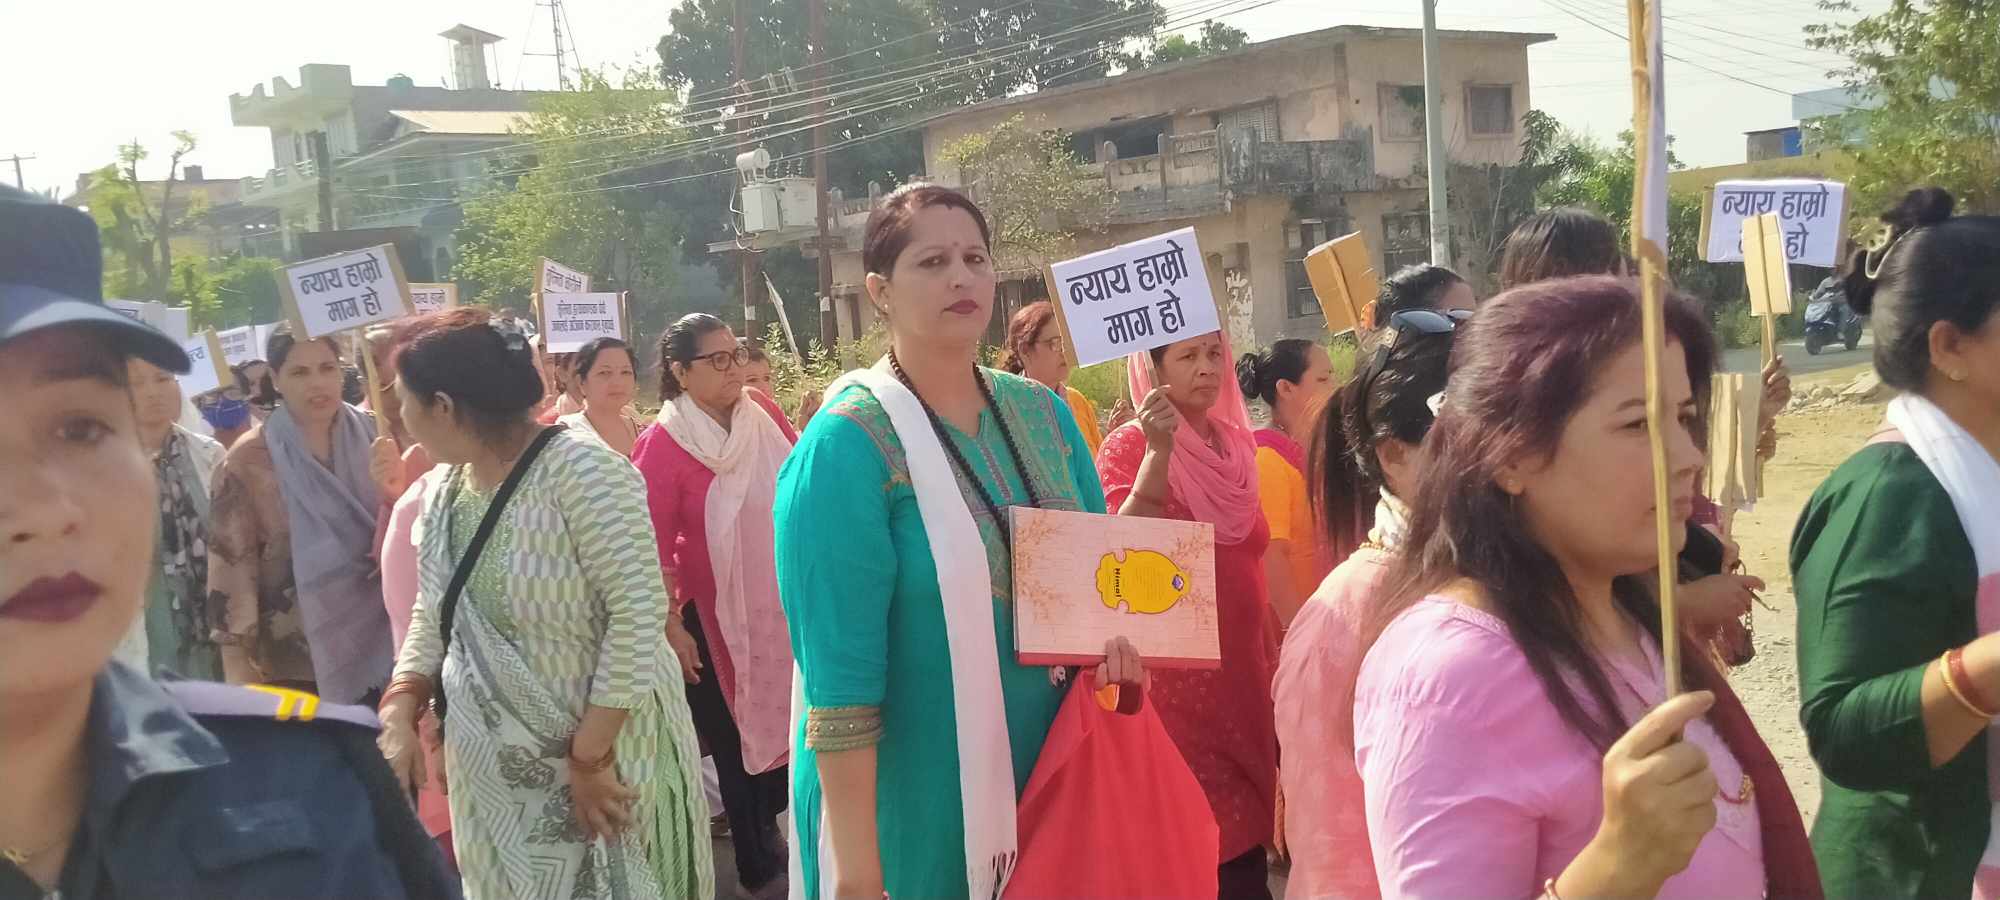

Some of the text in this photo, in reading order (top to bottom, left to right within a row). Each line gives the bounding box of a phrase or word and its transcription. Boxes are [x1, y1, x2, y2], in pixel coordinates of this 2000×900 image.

[1722, 183, 1829, 221] न्याय हाम्रो
[1786, 223, 1809, 259] हो
[298, 253, 383, 295] न्याय हाम्रो
[1066, 239, 1189, 306] न्याय हाम्रो
[325, 287, 382, 322] माग हो
[1103, 289, 1186, 345] माग हो
